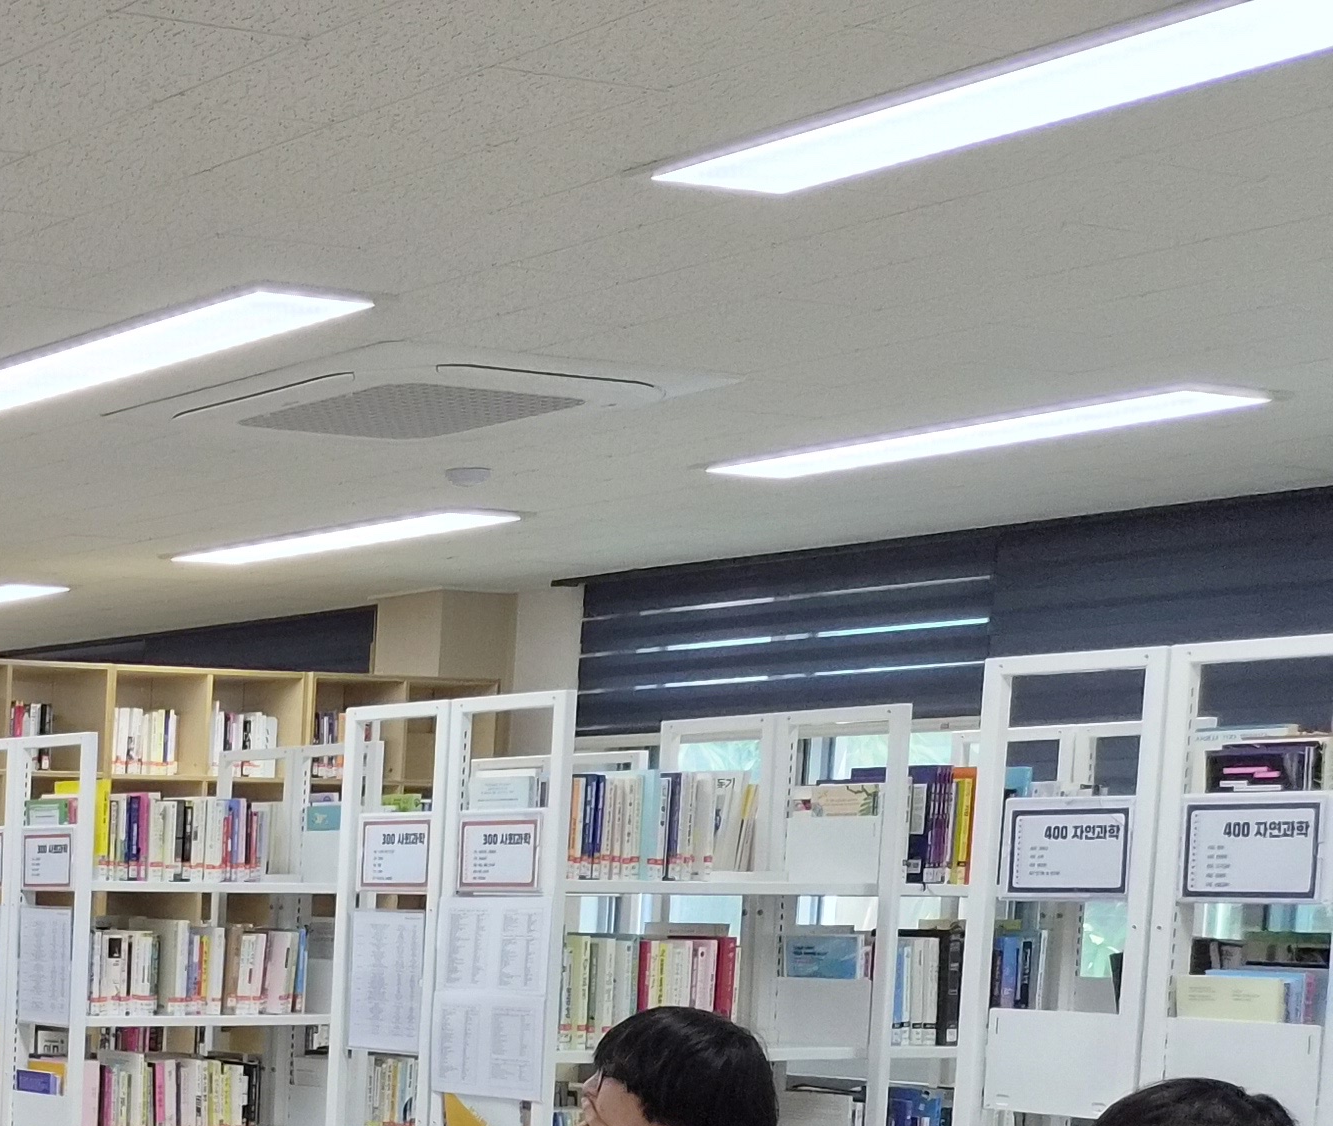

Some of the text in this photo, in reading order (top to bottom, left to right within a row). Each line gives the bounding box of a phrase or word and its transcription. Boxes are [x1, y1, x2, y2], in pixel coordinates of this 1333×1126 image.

[1044, 824, 1121, 840] 400 자연과학
[1223, 820, 1310, 838] 400 자연과학
[382, 833, 395, 845] 300
[483, 832, 531, 845] 300 사회과학
